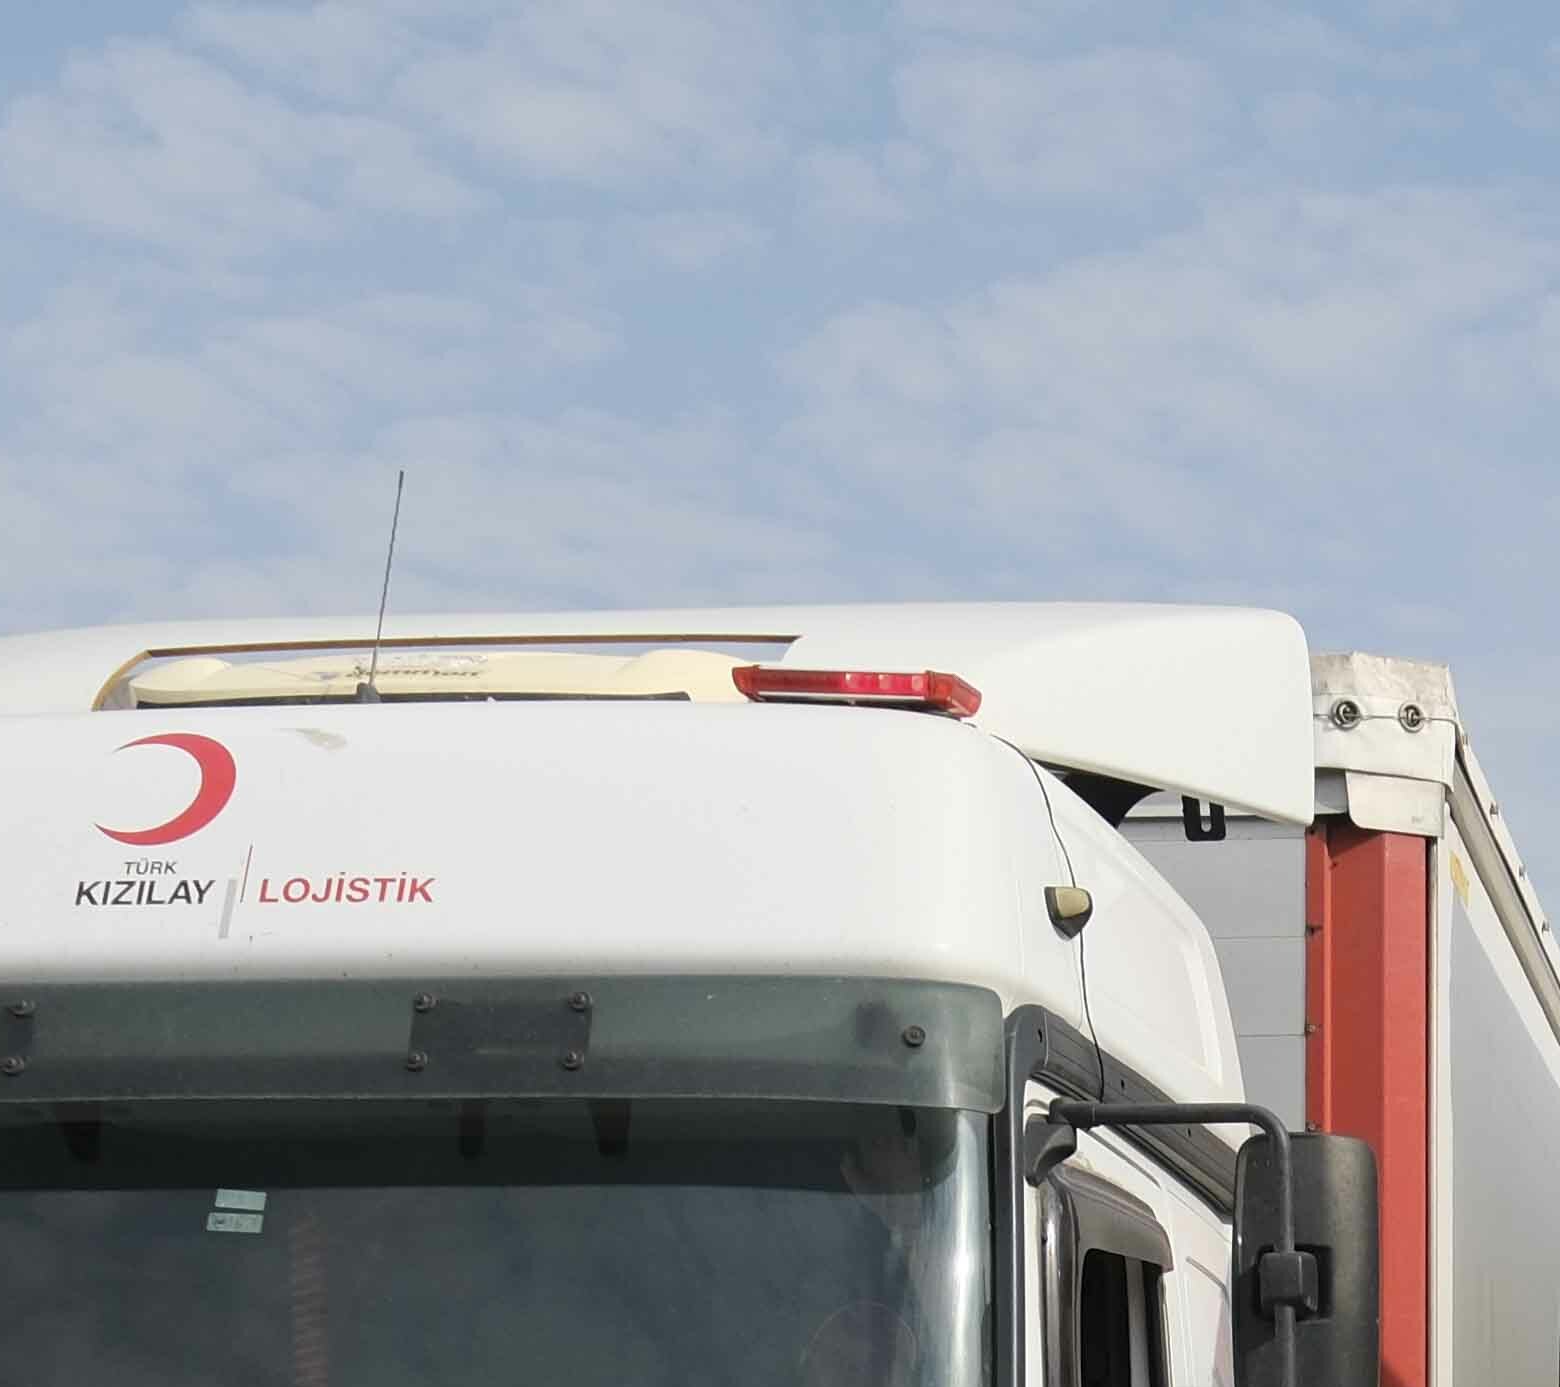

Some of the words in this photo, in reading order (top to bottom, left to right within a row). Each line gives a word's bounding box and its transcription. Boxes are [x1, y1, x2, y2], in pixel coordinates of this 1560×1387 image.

[124, 857, 178, 876] TÜRK
[74, 880, 216, 906] KIZILAY
[258, 871, 435, 904] LOJİSTİK
